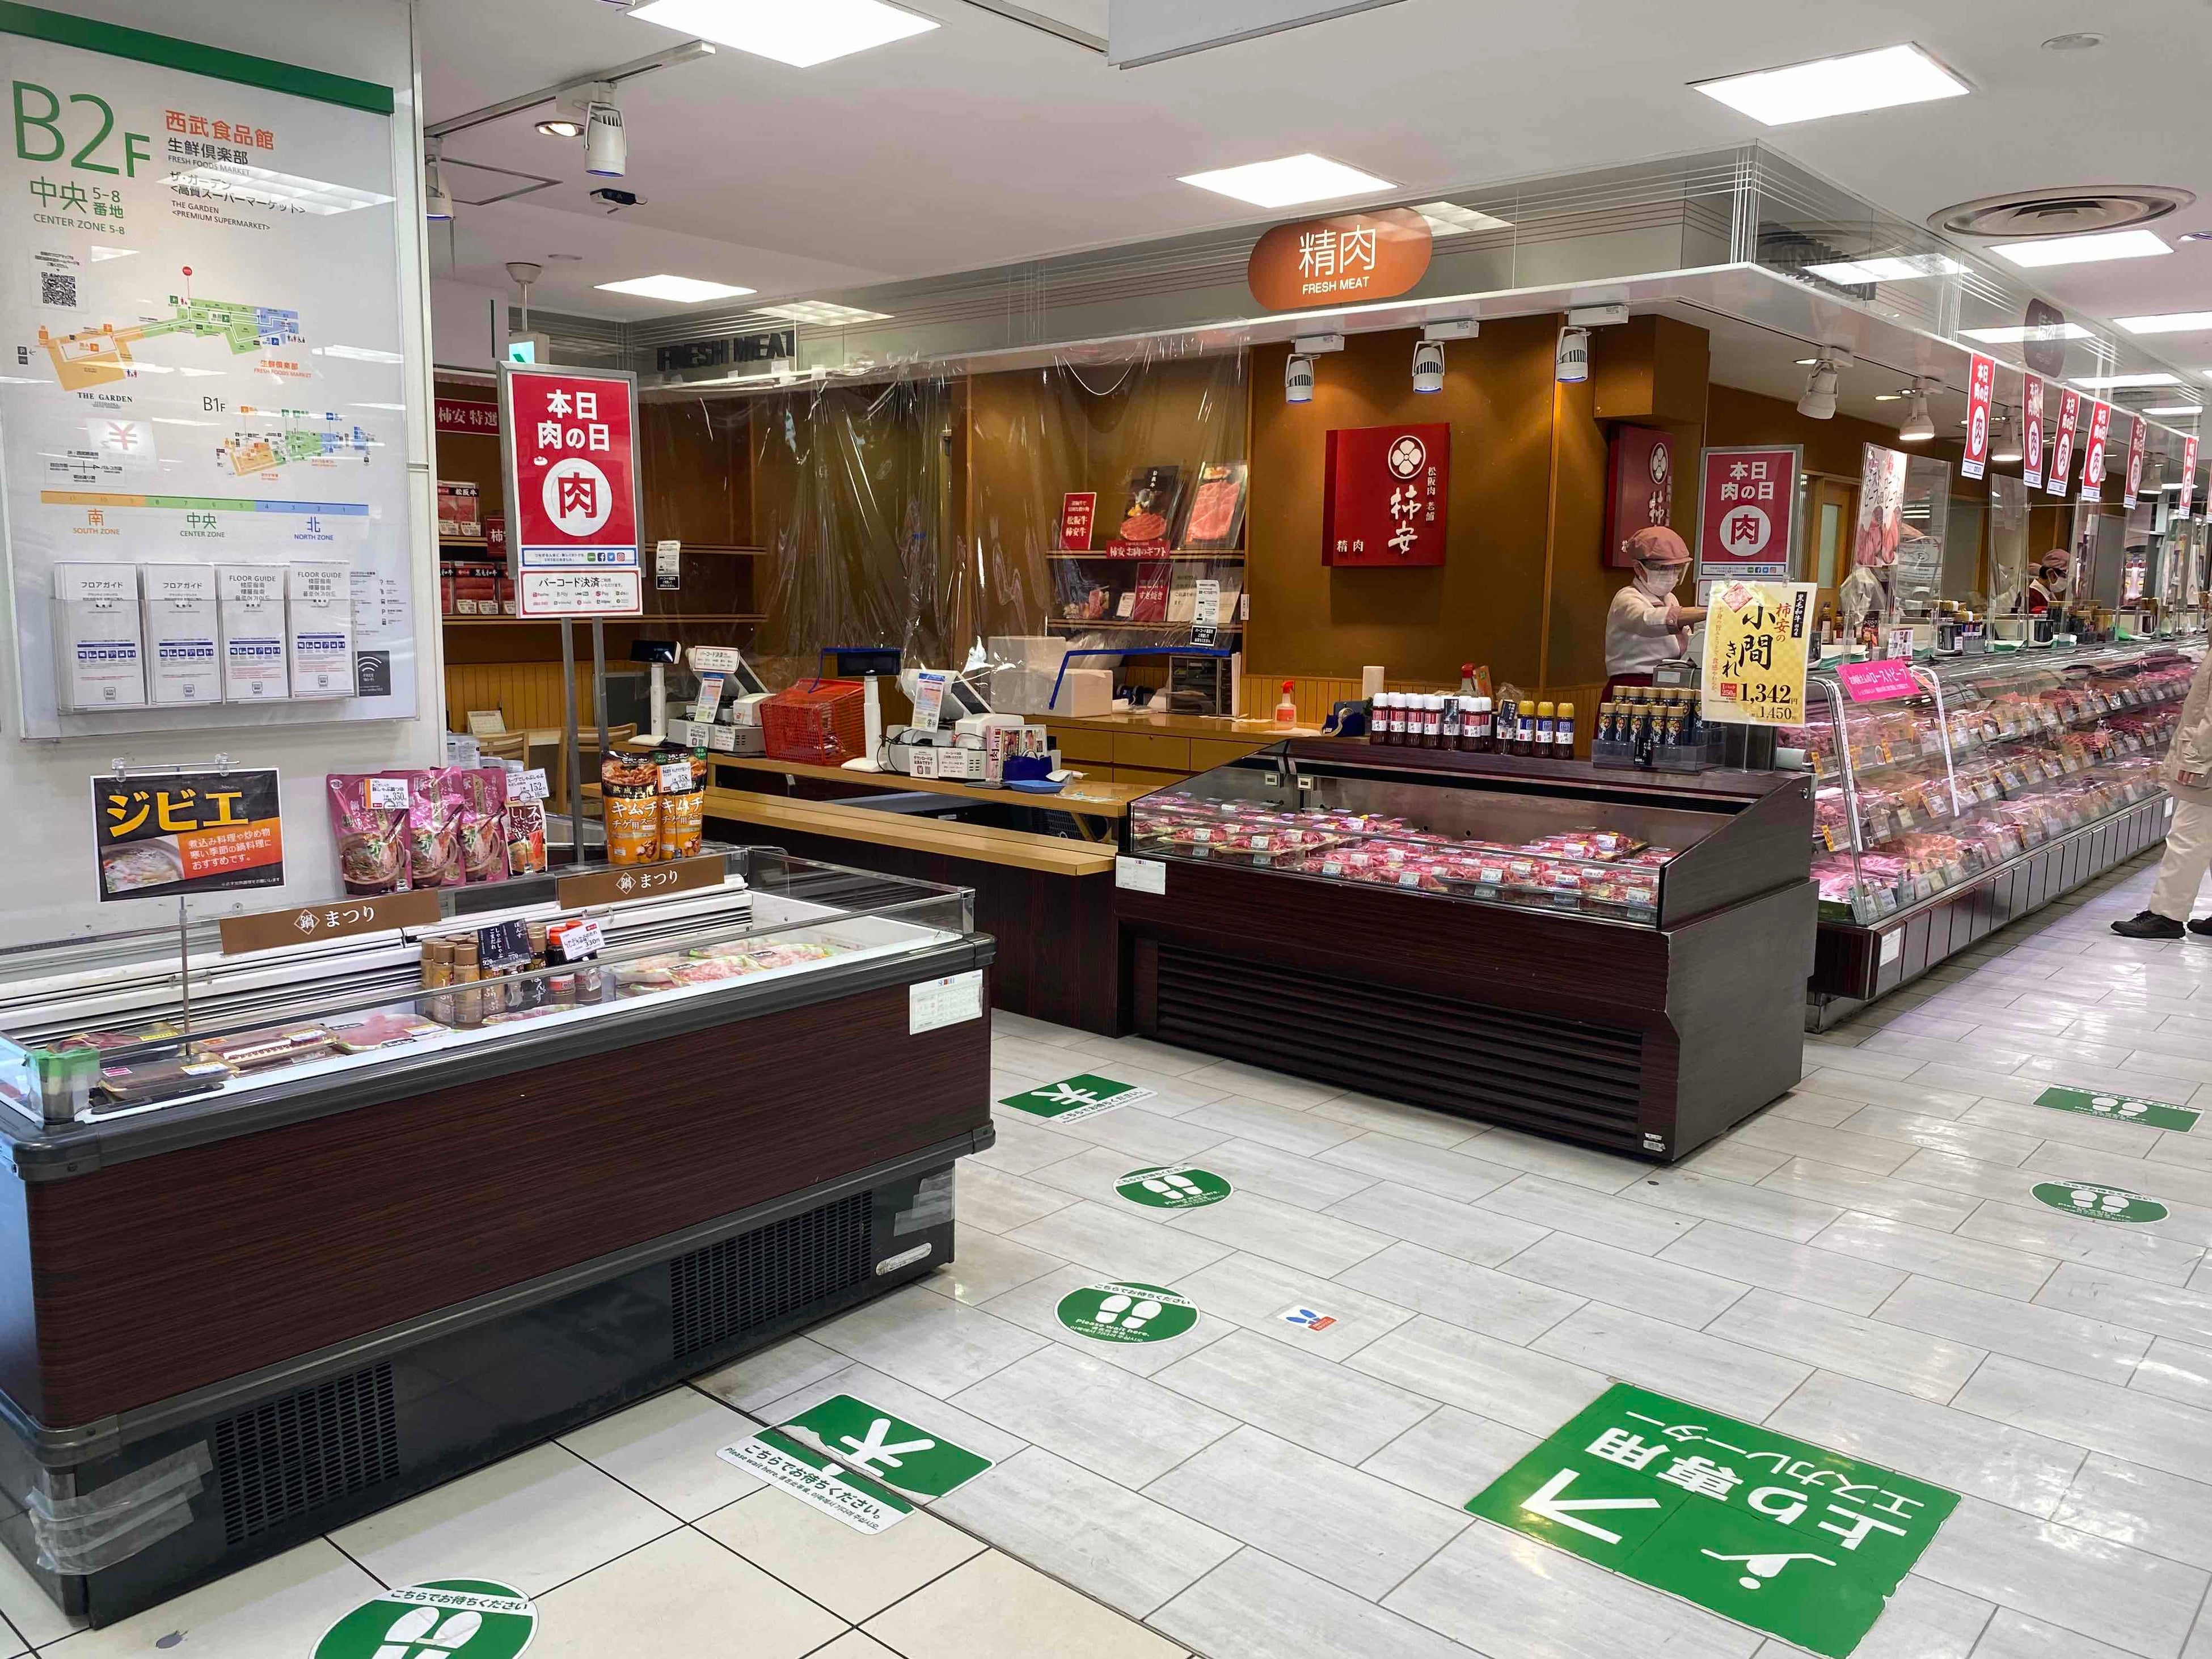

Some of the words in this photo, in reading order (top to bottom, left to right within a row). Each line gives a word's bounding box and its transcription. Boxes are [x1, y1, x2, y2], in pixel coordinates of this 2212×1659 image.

[12, 80, 150, 178] B2F
[165, 109, 275, 151] 西武食品館
[168, 155, 191, 167] FRESH
[192, 158, 218, 170] FOODS
[219, 163, 250, 177] MARKET
[29, 176, 88, 214] 中央
[92, 201, 124, 219] 番地
[172, 200, 186, 210] THE
[188, 202, 219, 214] GARDEN
[33, 214, 75, 229] CENTER
[78, 218, 106, 233] ZONE
[1299, 225, 1377, 278] 精肉
[1302, 281, 1337, 295] FRESH
[1340, 276, 1370, 290] MEAT
[1977, 362, 1989, 383] 本日
[99, 394, 133, 403] GARDEN
[1974, 382, 1989, 403] 肉の日
[203, 396, 226, 412] B1F
[547, 389, 598, 420] 本日
[2065, 396, 2075, 413] 本日
[438, 407, 466, 424] 柿安
[470, 410, 498, 426] 特選
[2062, 413, 2075, 431] 肉の日
[2097, 408, 2107, 425] 本日
[537, 420, 610, 452] 肉の日
[2094, 424, 2107, 441] 肉の日
[1427, 466, 1437, 496] 松阪肉
[1729, 461, 1768, 481] 本日
[558, 472, 598, 519] 肉
[1720, 482, 1774, 501] 肉の日
[88, 509, 104, 527] 南
[187, 512, 217, 530] 中央
[307, 517, 320, 533] 北
[1388, 485, 1422, 555] 柿安
[1730, 514, 1761, 546] 肉
[1336, 539, 1364, 554] 精肉
[539, 577, 601, 588] バーコード決済
[1793, 593, 1805, 623] 黒毛和牛
[1774, 603, 1792, 643] 柿安の
[1738, 606, 1776, 671] 小間
[1722, 640, 1741, 678] きれ
[107, 788, 249, 837] ジビエ
[612, 801, 657, 818] キムチ
[661, 797, 703, 814] キムチ
[613, 819, 639, 830] チゲ用
[188, 828, 271, 849] 煮込み料理や炒め物
[189, 839, 272, 859] 寒い季節の鍋料理に
[192, 855, 252, 870] おすすめです。
[619, 875, 634, 892] 鍋
[640, 870, 679, 889] まつり
[299, 914, 315, 930] 鍋
[324, 906, 375, 929] まつり
[1095, 1284, 1191, 1305] こちらでお待ちください
[1075, 1318, 1104, 1328] Please
[725, 1447, 748, 1460] Please
[746, 1458, 762, 1470] wait
[762, 1466, 779, 1478] here.
[1626, 1411, 1925, 1519] エスカレーター
[744, 1445, 880, 1519] こちらでお待ちください。
[1584, 1427, 1907, 1551] 上り専用
[390, 1589, 528, 1611] こちらでお待ちください
